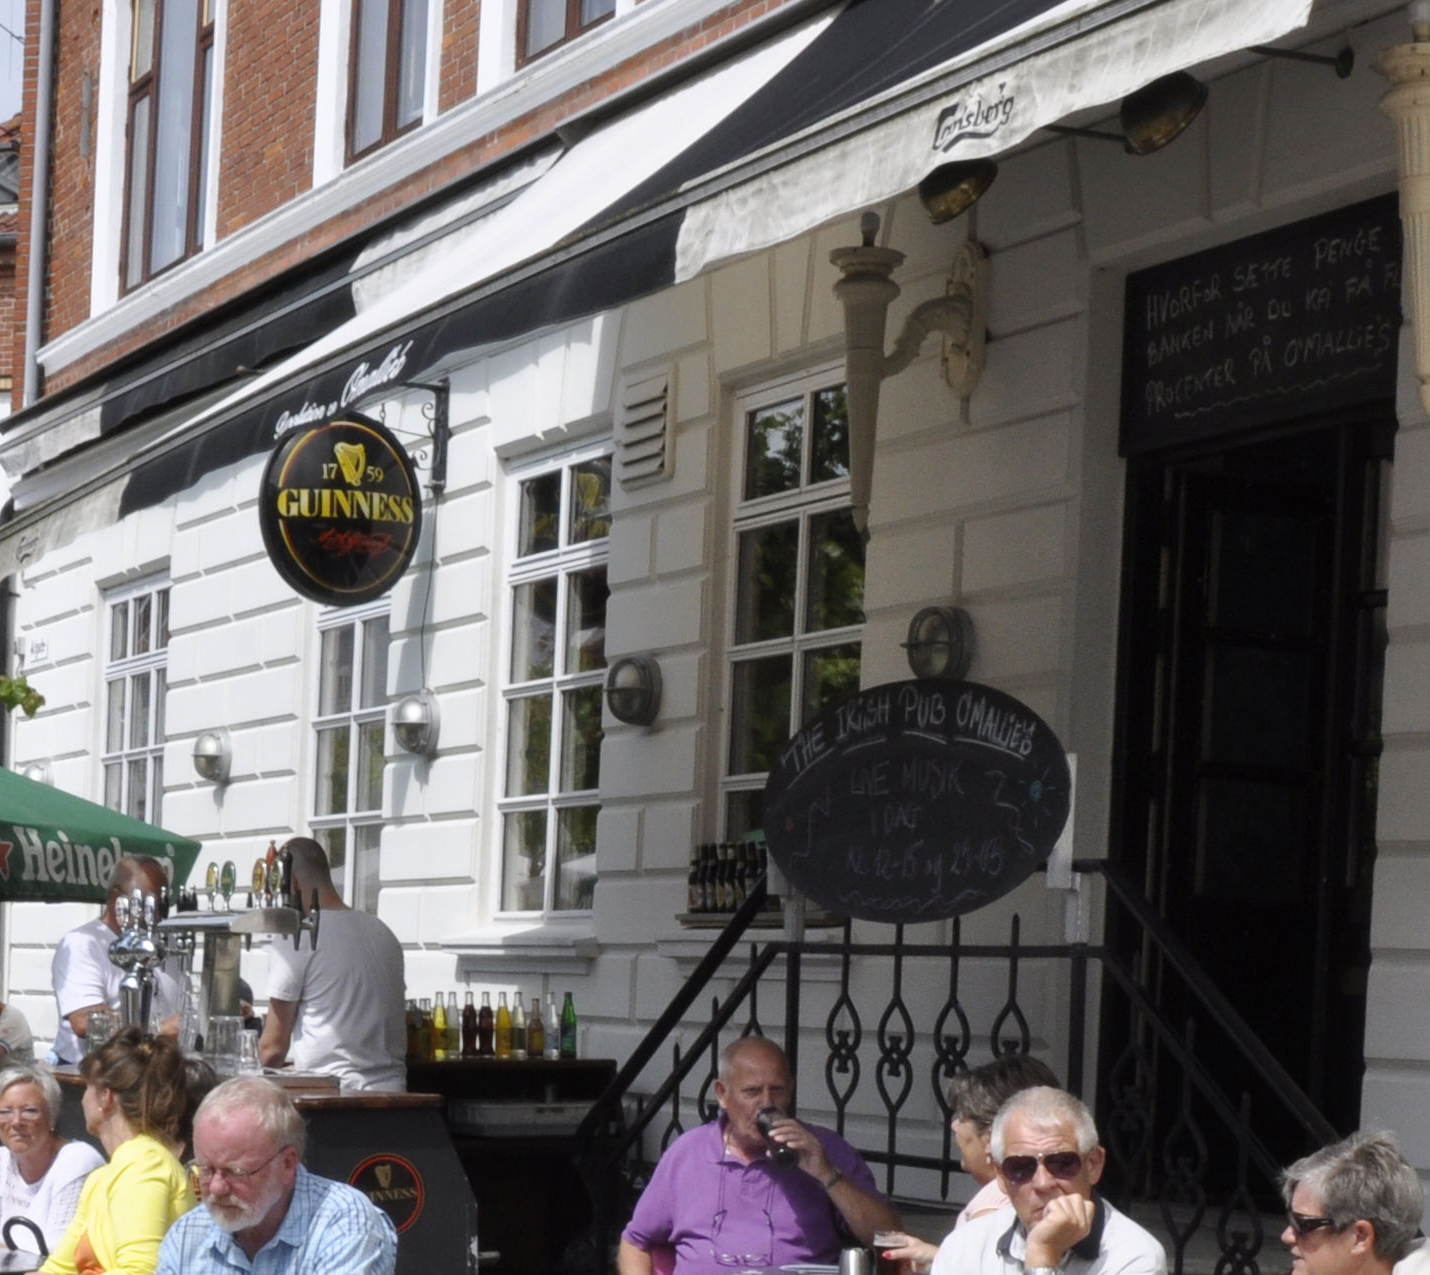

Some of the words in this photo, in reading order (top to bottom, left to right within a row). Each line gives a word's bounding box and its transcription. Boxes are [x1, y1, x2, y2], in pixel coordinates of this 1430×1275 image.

[932, 95, 1014, 152] Carlsberg
[322, 463, 338, 480] 17
[366, 466, 384, 482] 59
[277, 488, 414, 524] GUINNESS
[781, 722, 827, 773] THE
[898, 686, 947, 730] PUB
